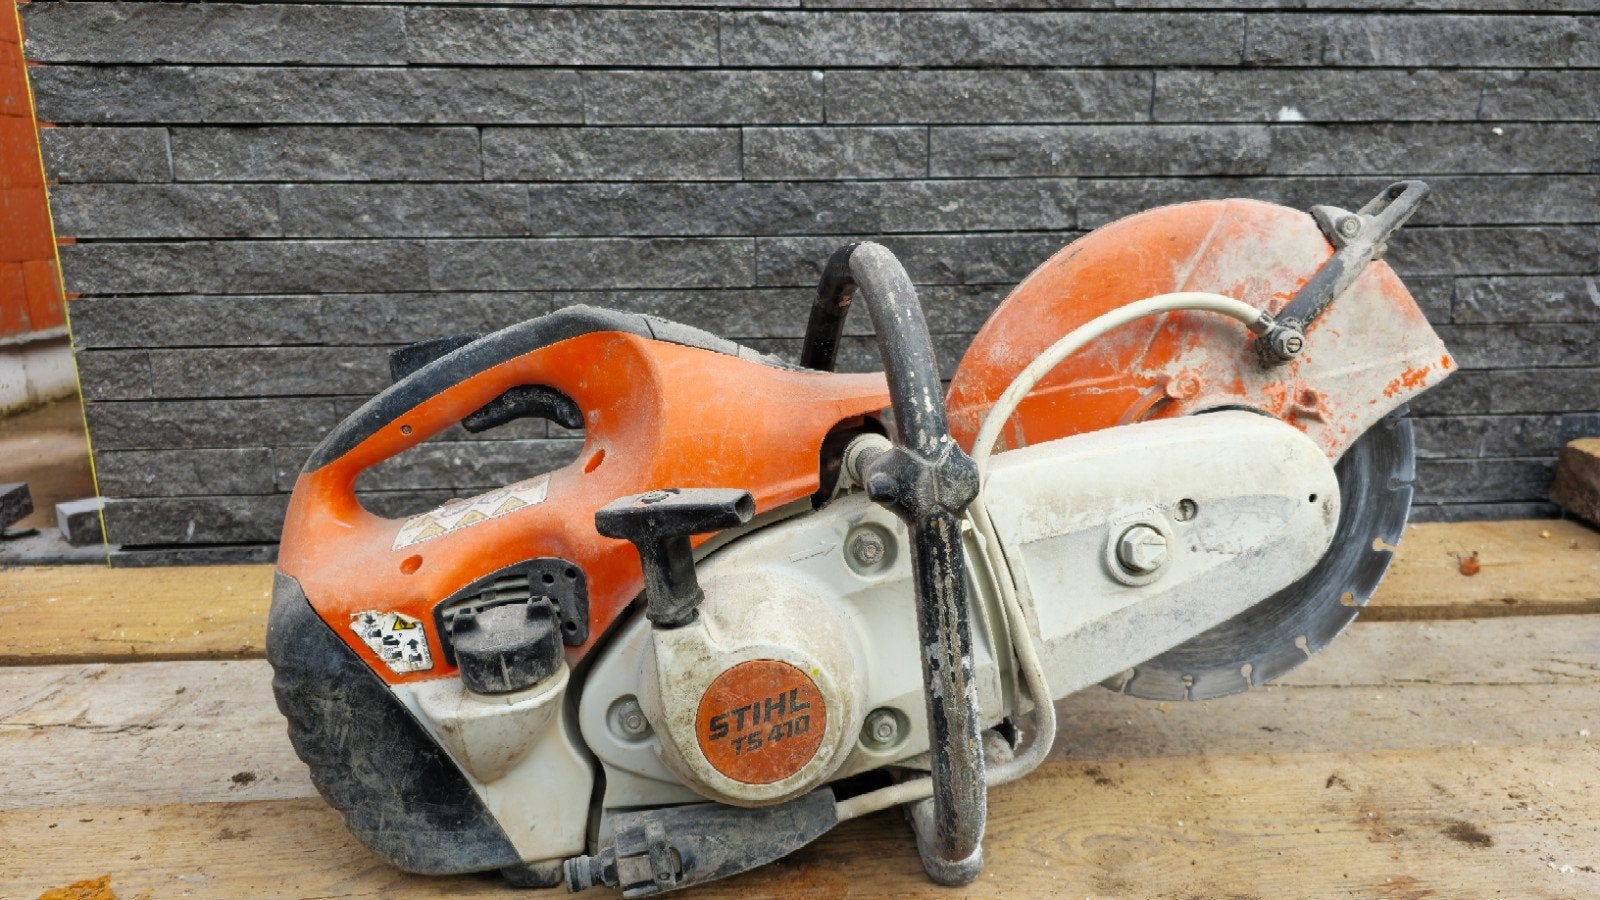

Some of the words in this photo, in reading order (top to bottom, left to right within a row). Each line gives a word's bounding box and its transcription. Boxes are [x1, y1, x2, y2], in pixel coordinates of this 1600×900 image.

[709, 688, 811, 740] STIHL
[731, 730, 763, 756] TS
[767, 715, 811, 742] 410
